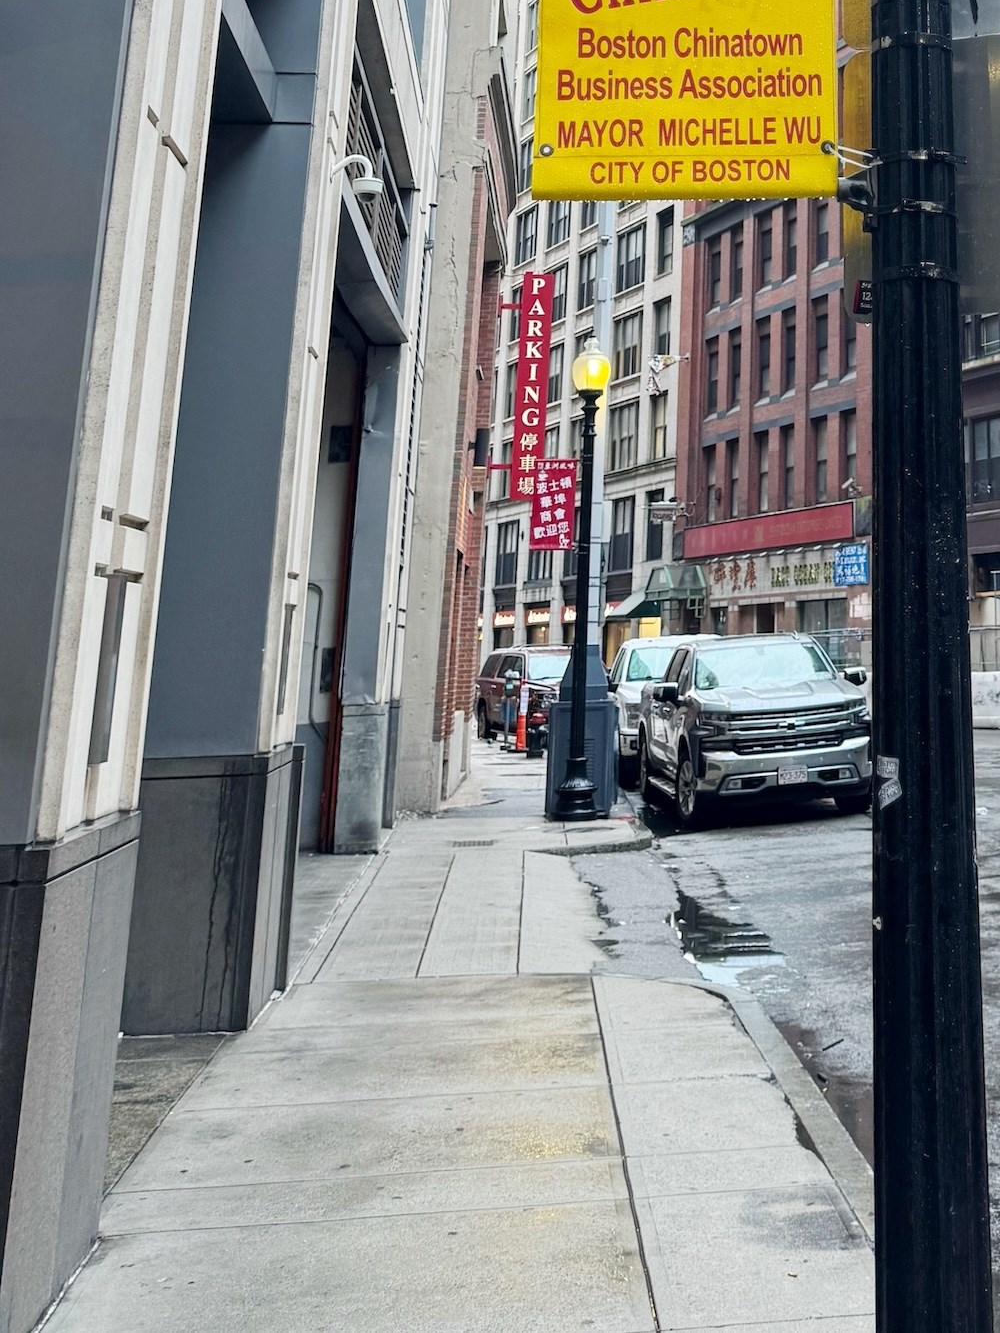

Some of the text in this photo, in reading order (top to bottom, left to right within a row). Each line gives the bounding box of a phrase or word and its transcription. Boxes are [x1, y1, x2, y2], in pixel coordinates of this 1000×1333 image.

[577, 27, 803, 59] Boston Chinatown
[557, 67, 822, 101] Business Association
[557, 116, 821, 149] MAYOR MICHELLE WU
[590, 158, 791, 185] CITY OF BOSTON
[521, 277, 546, 427] PARKING
[517, 432, 538, 495] 停車場
[536, 476, 572, 495] 波士頓
[540, 493, 566, 508] 華埠
[540, 507, 565, 524] 商會
